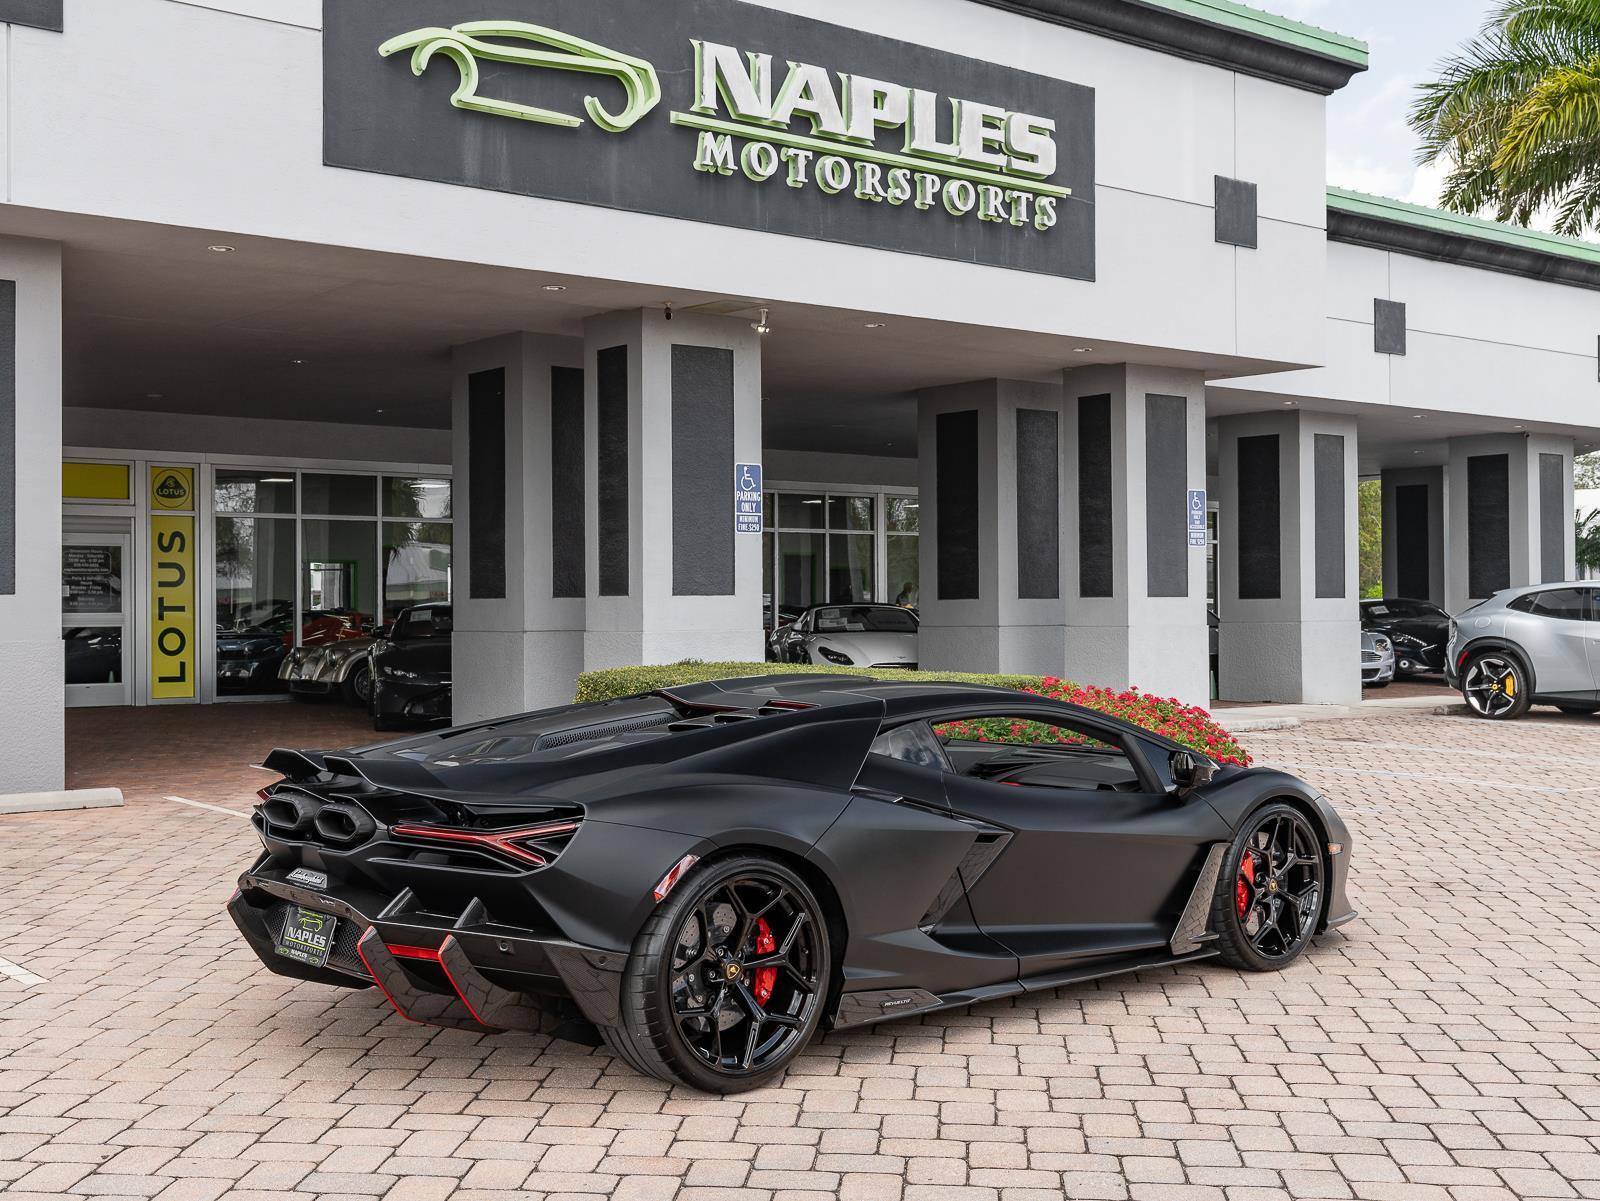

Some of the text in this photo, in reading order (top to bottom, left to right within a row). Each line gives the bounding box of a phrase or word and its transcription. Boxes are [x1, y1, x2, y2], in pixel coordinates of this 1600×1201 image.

[689, 39, 1056, 178] NAPLES
[693, 132, 1057, 230] MOTORSPORTS
[158, 488, 185, 496] LOTUS
[736, 491, 761, 502] PARKING
[741, 502, 756, 512] ONLY
[158, 531, 186, 683] LOTUS
[287, 926, 327, 947] NAPLES
[285, 940, 323, 957] MOTORSPORTS
